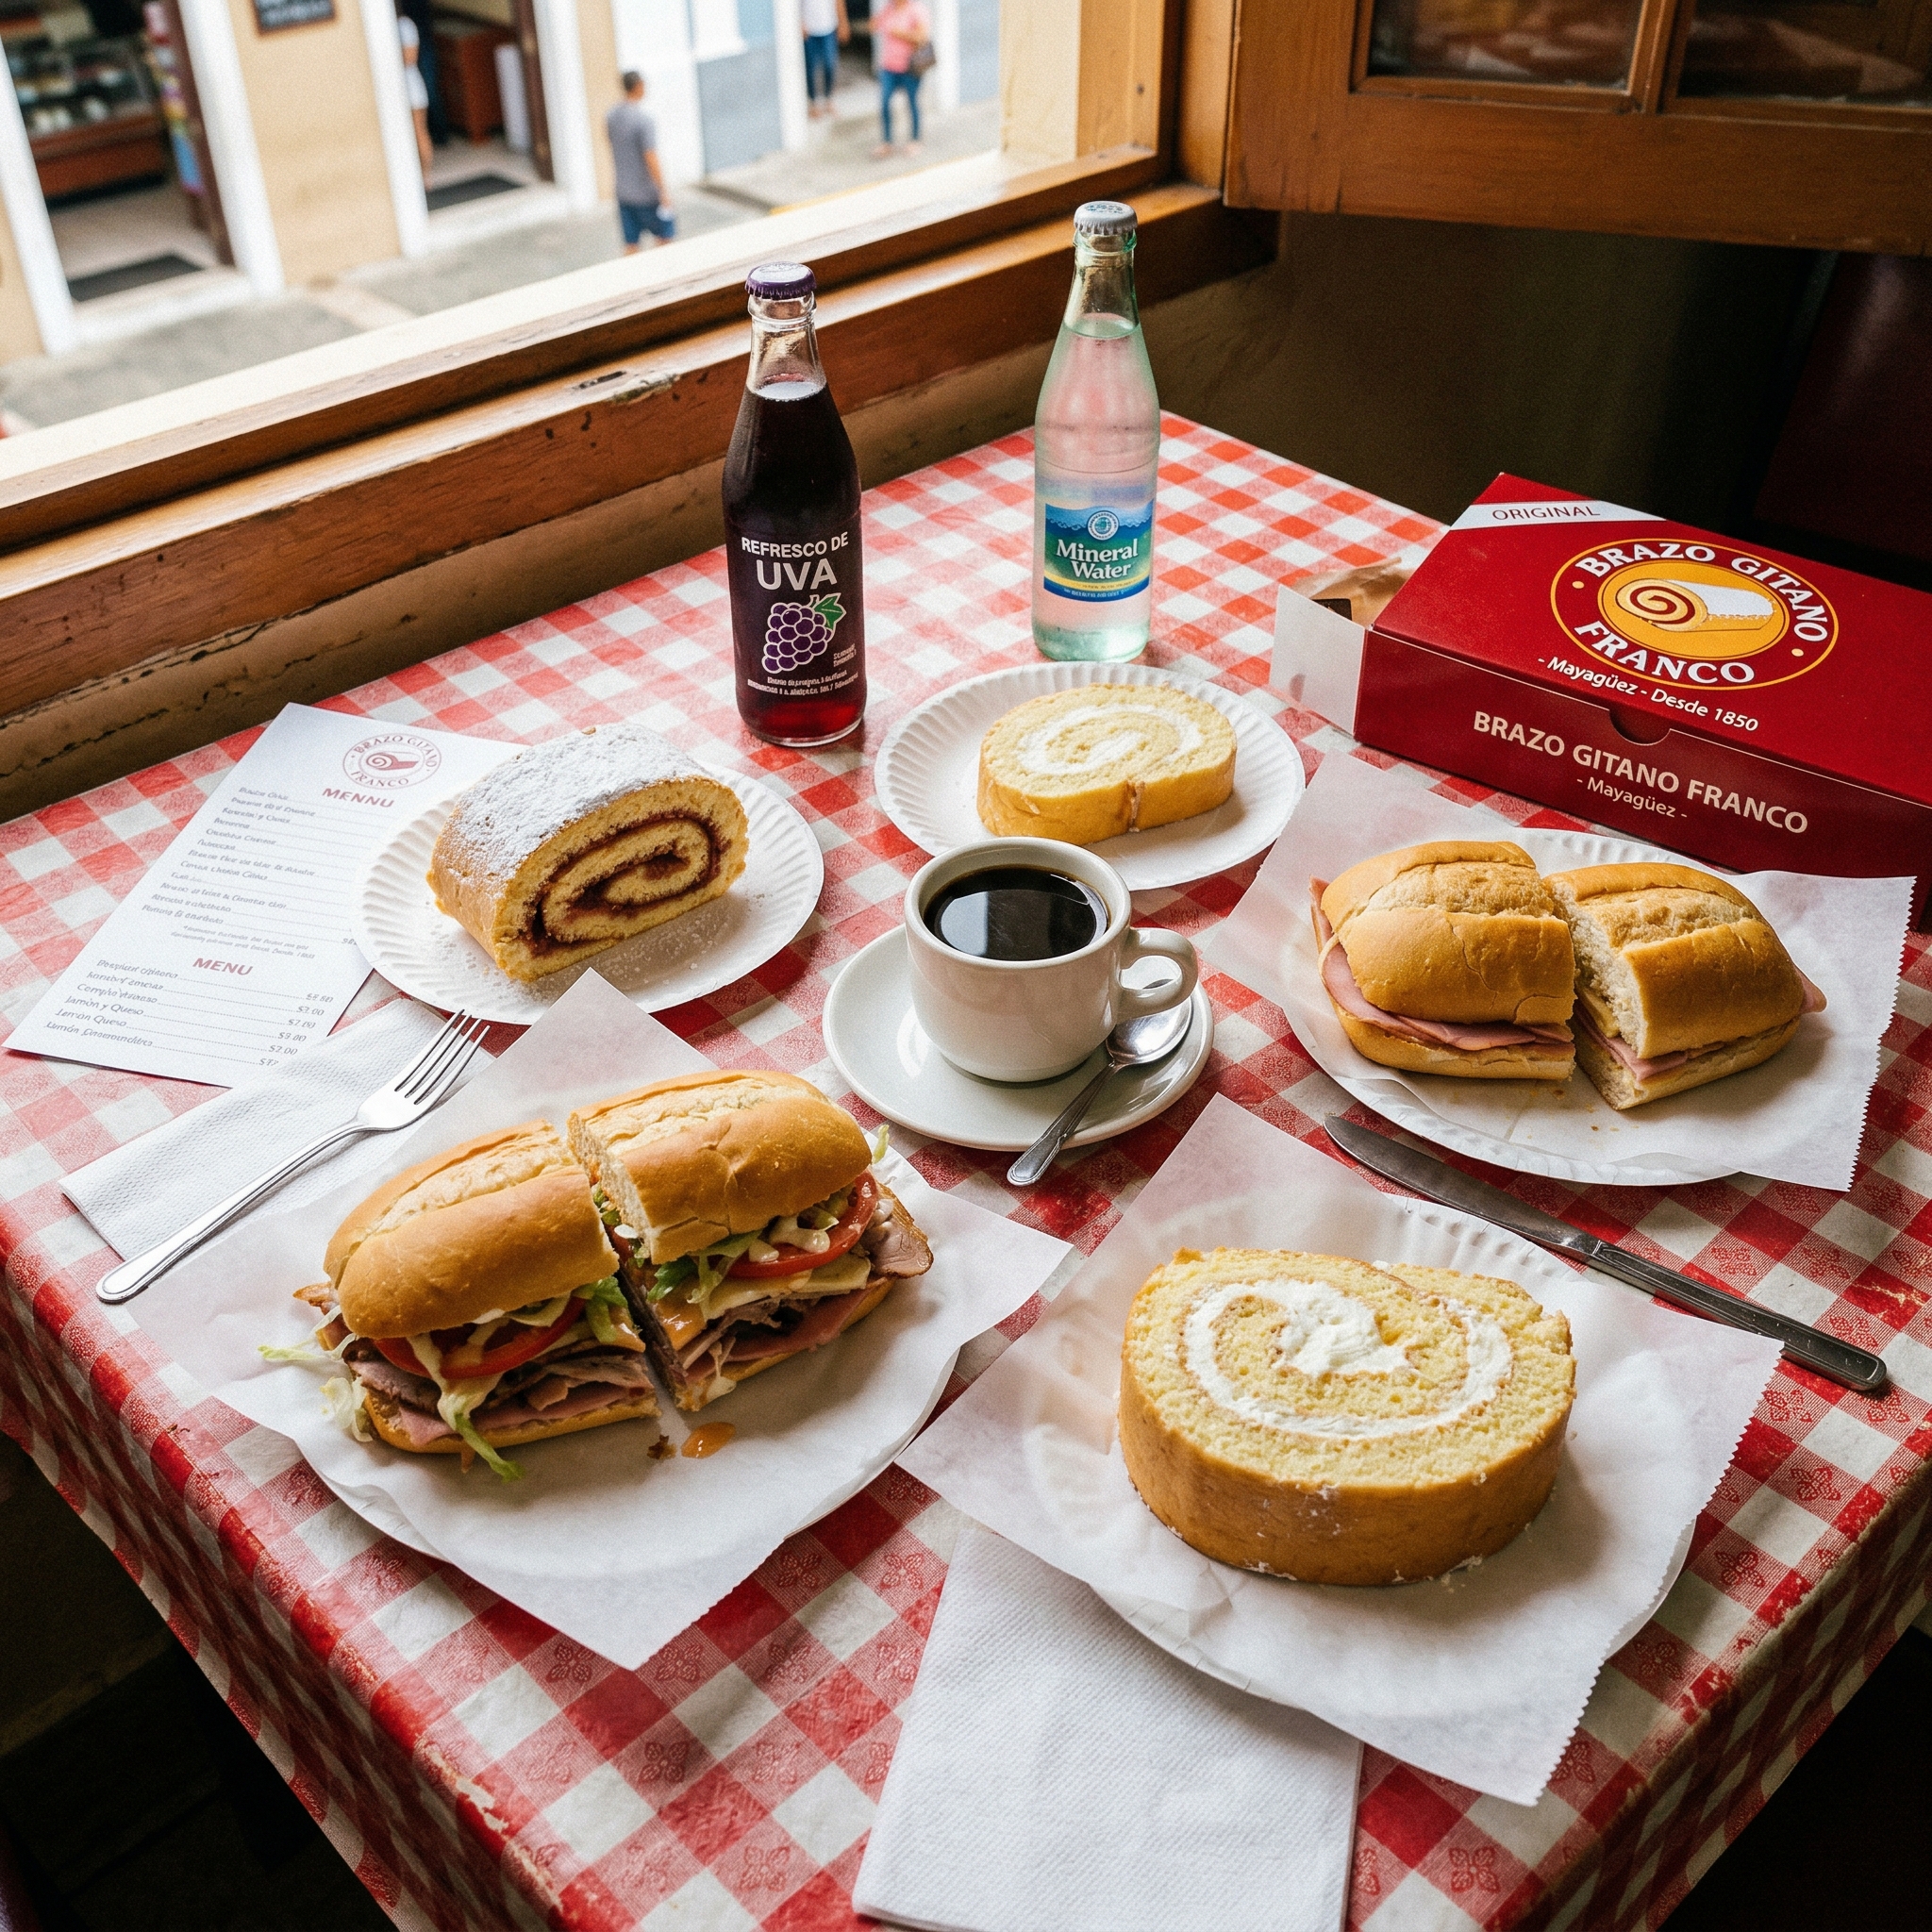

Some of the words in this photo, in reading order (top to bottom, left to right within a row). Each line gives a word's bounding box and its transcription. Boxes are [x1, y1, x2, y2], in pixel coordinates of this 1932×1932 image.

[1491, 505, 1601, 521] ORIGINAL
[741, 537, 827, 558] REFRESCO
[831, 531, 849, 551] DE
[1056, 538, 1139, 563] Mineral
[756, 558, 838, 591] UVA
[1071, 560, 1132, 580] Water
[1575, 542, 1716, 577] BRAZO
[1730, 556, 1828, 641] GITANO
[1574, 620, 1755, 684] FRANCO
[1547, 656, 1640, 696] Mayagüez
[1651, 688, 1709, 717] Desde
[1714, 708, 1759, 732] 1850
[353, 735, 403, 755] BRAZO
[1474, 710, 1565, 757] BRAZO
[1573, 744, 1680, 794] GITANO
[1687, 777, 1809, 835] FRANCO
[322, 788, 395, 808] MENNU
[1587, 776, 1676, 819] Mayagüez
[192, 958, 254, 975] MENU
